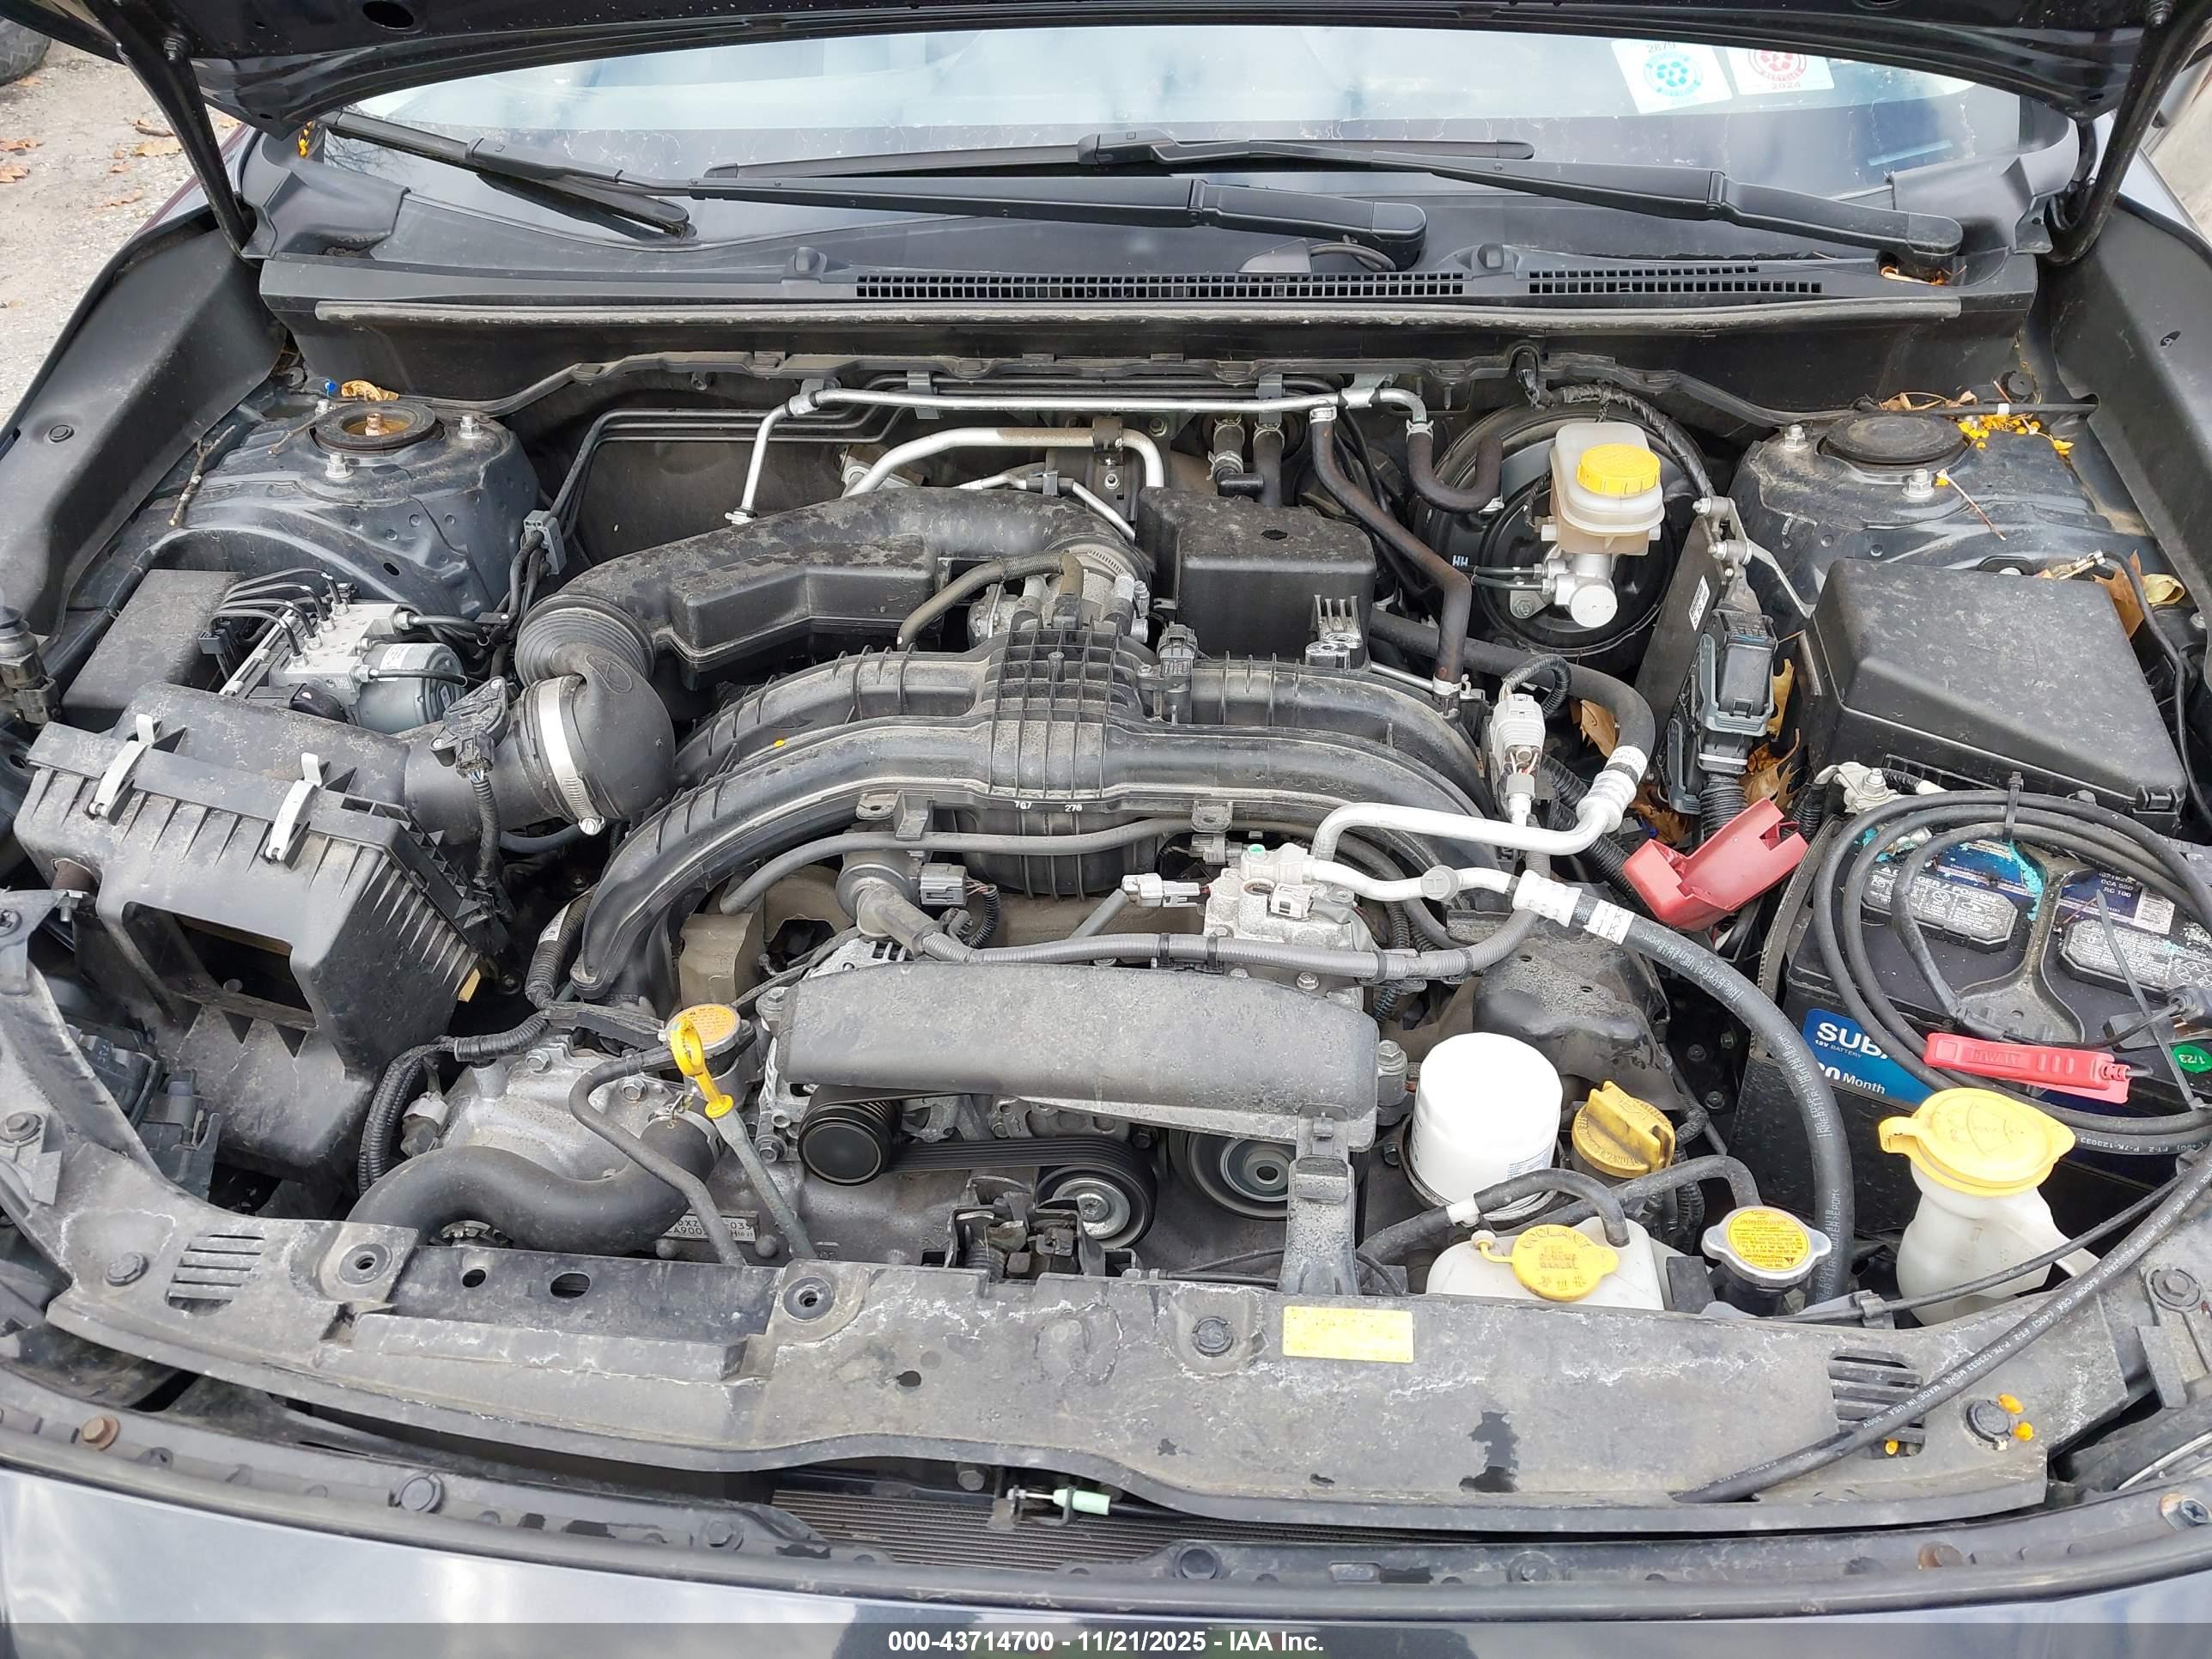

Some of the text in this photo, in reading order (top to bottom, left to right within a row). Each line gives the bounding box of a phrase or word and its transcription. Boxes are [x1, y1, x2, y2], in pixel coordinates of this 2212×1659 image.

[1452, 556, 1468, 567] HH
[1953, 885, 1996, 903] POISON
[2117, 890, 2131, 898] 100
[1831, 1045, 1863, 1058] BATTERY
[1844, 1073, 1886, 1094] Month
[1521, 1226, 1591, 1249] COOLANT
[2055, 1297, 2073, 1311] CSA
[1917, 1384, 1941, 1402] MADE
[1906, 1397, 1917, 1407] IN
[1887, 1404, 1905, 1416] USA
